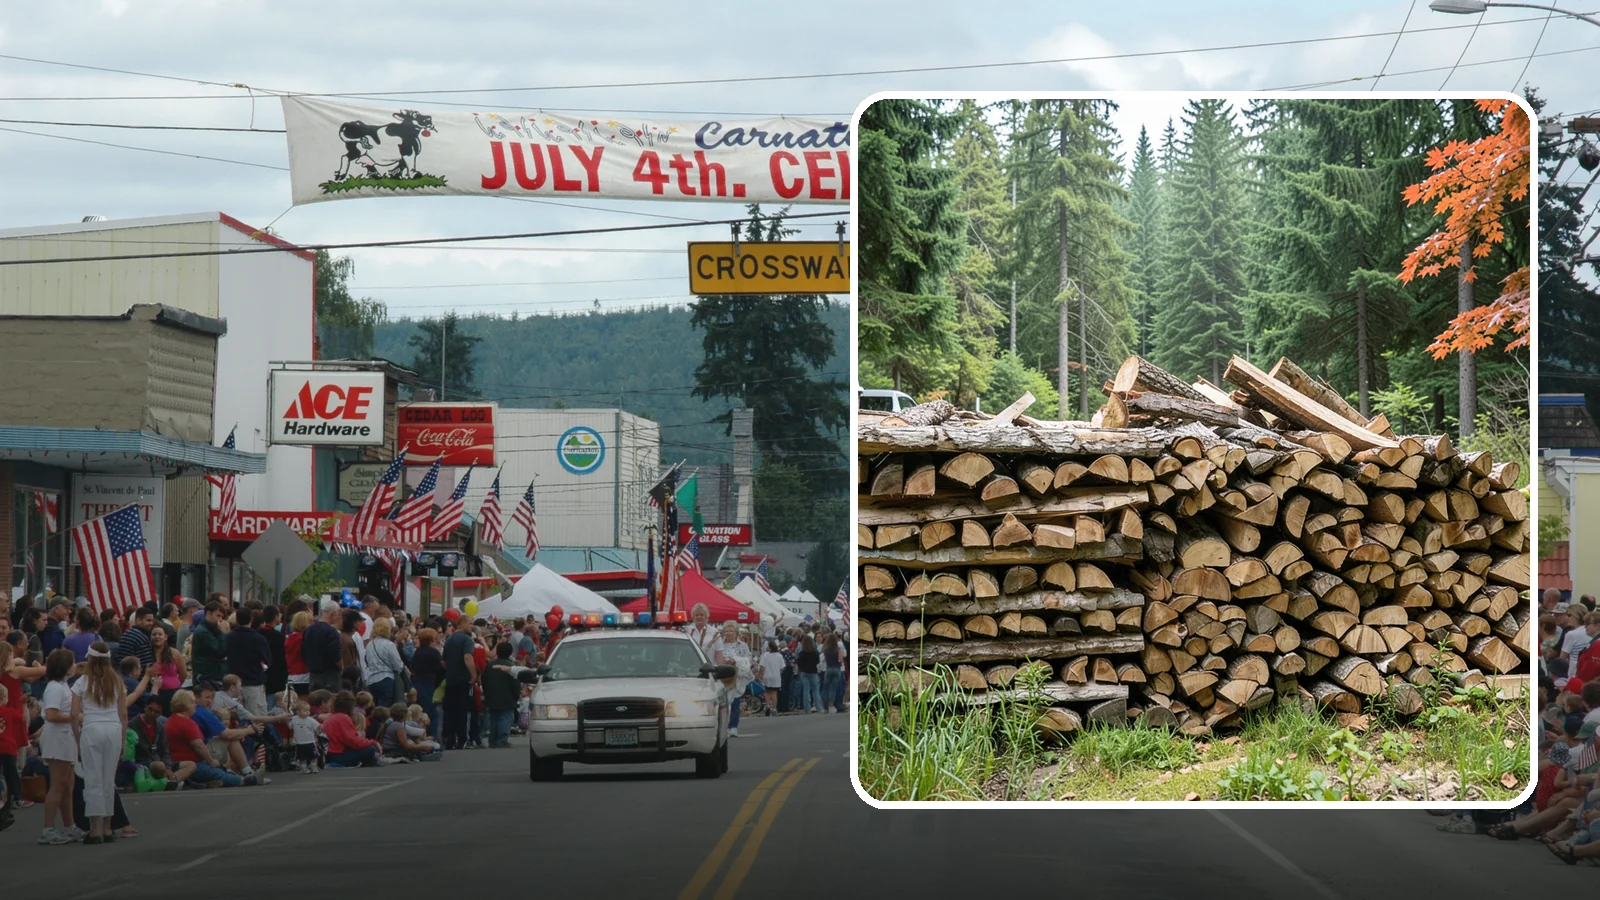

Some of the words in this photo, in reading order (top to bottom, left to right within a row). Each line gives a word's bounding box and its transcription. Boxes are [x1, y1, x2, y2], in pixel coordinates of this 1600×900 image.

[481, 141, 605, 193] JULY
[632, 150, 747, 198] 4th.
[697, 254, 850, 280] CROSSWA
[283, 380, 374, 420] ACE
[405, 409, 453, 422] CEDAR
[283, 421, 371, 436] Hardware
[416, 427, 478, 447] Coca-Cola
[354, 467, 384, 480] Simpl
[83, 485, 93, 494] St.
[95, 485, 124, 495] Vincent
[126, 486, 136, 495] de
[137, 486, 155, 496] Paul
[688, 526, 741, 535] CRNATION
[698, 535, 731, 543] GLASS
